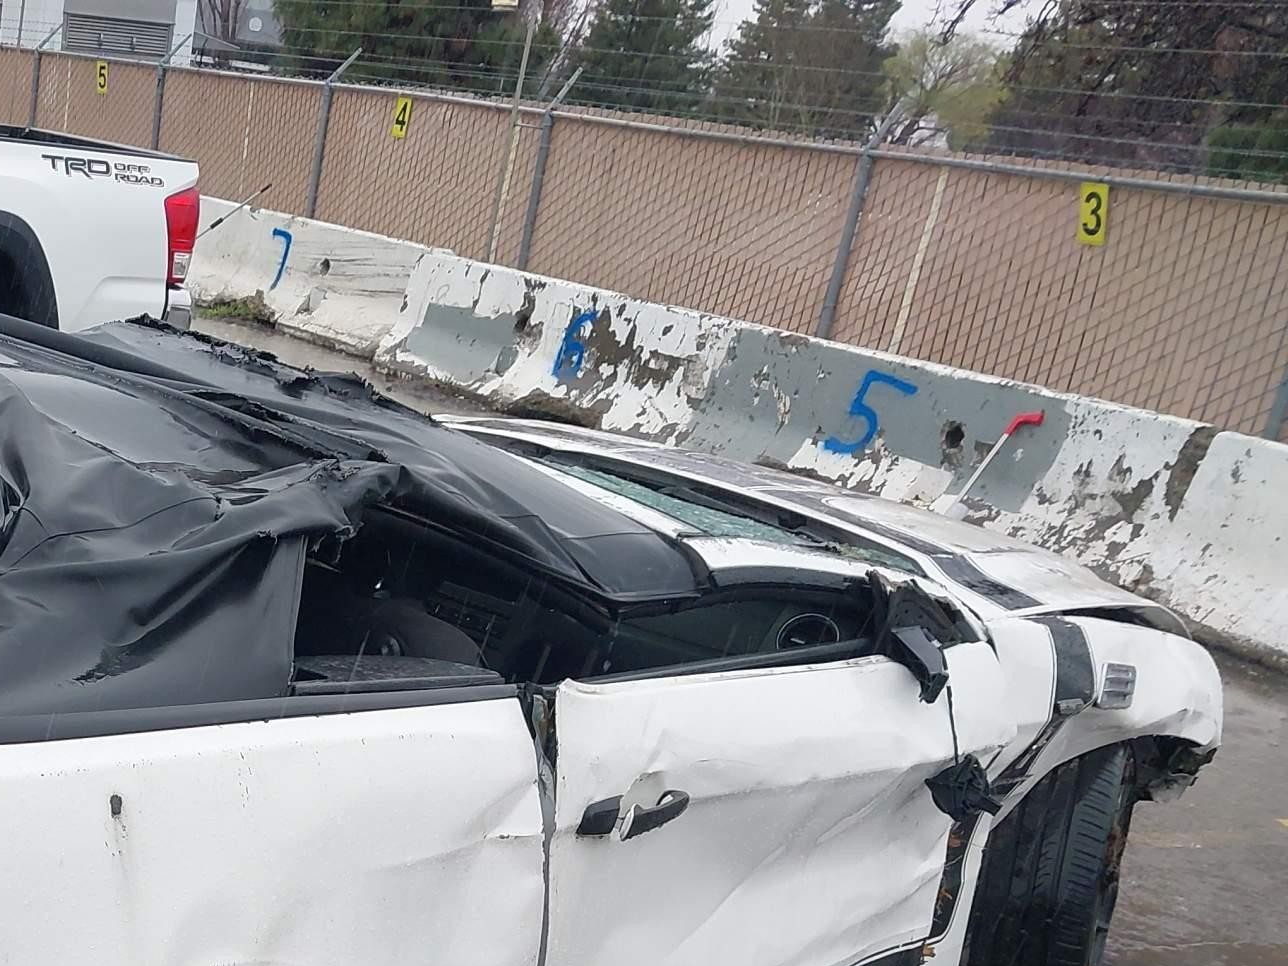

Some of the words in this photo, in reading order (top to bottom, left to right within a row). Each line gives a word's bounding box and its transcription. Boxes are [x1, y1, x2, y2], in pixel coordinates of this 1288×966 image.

[99, 65, 106, 89] 5
[395, 101, 408, 132] 4
[41, 154, 111, 180] TRD
[114, 163, 150, 175] OFF
[114, 173, 165, 187] ROAD
[1082, 191, 1102, 236] 3
[269, 227, 292, 292] 7
[823, 369, 918, 455] 5
